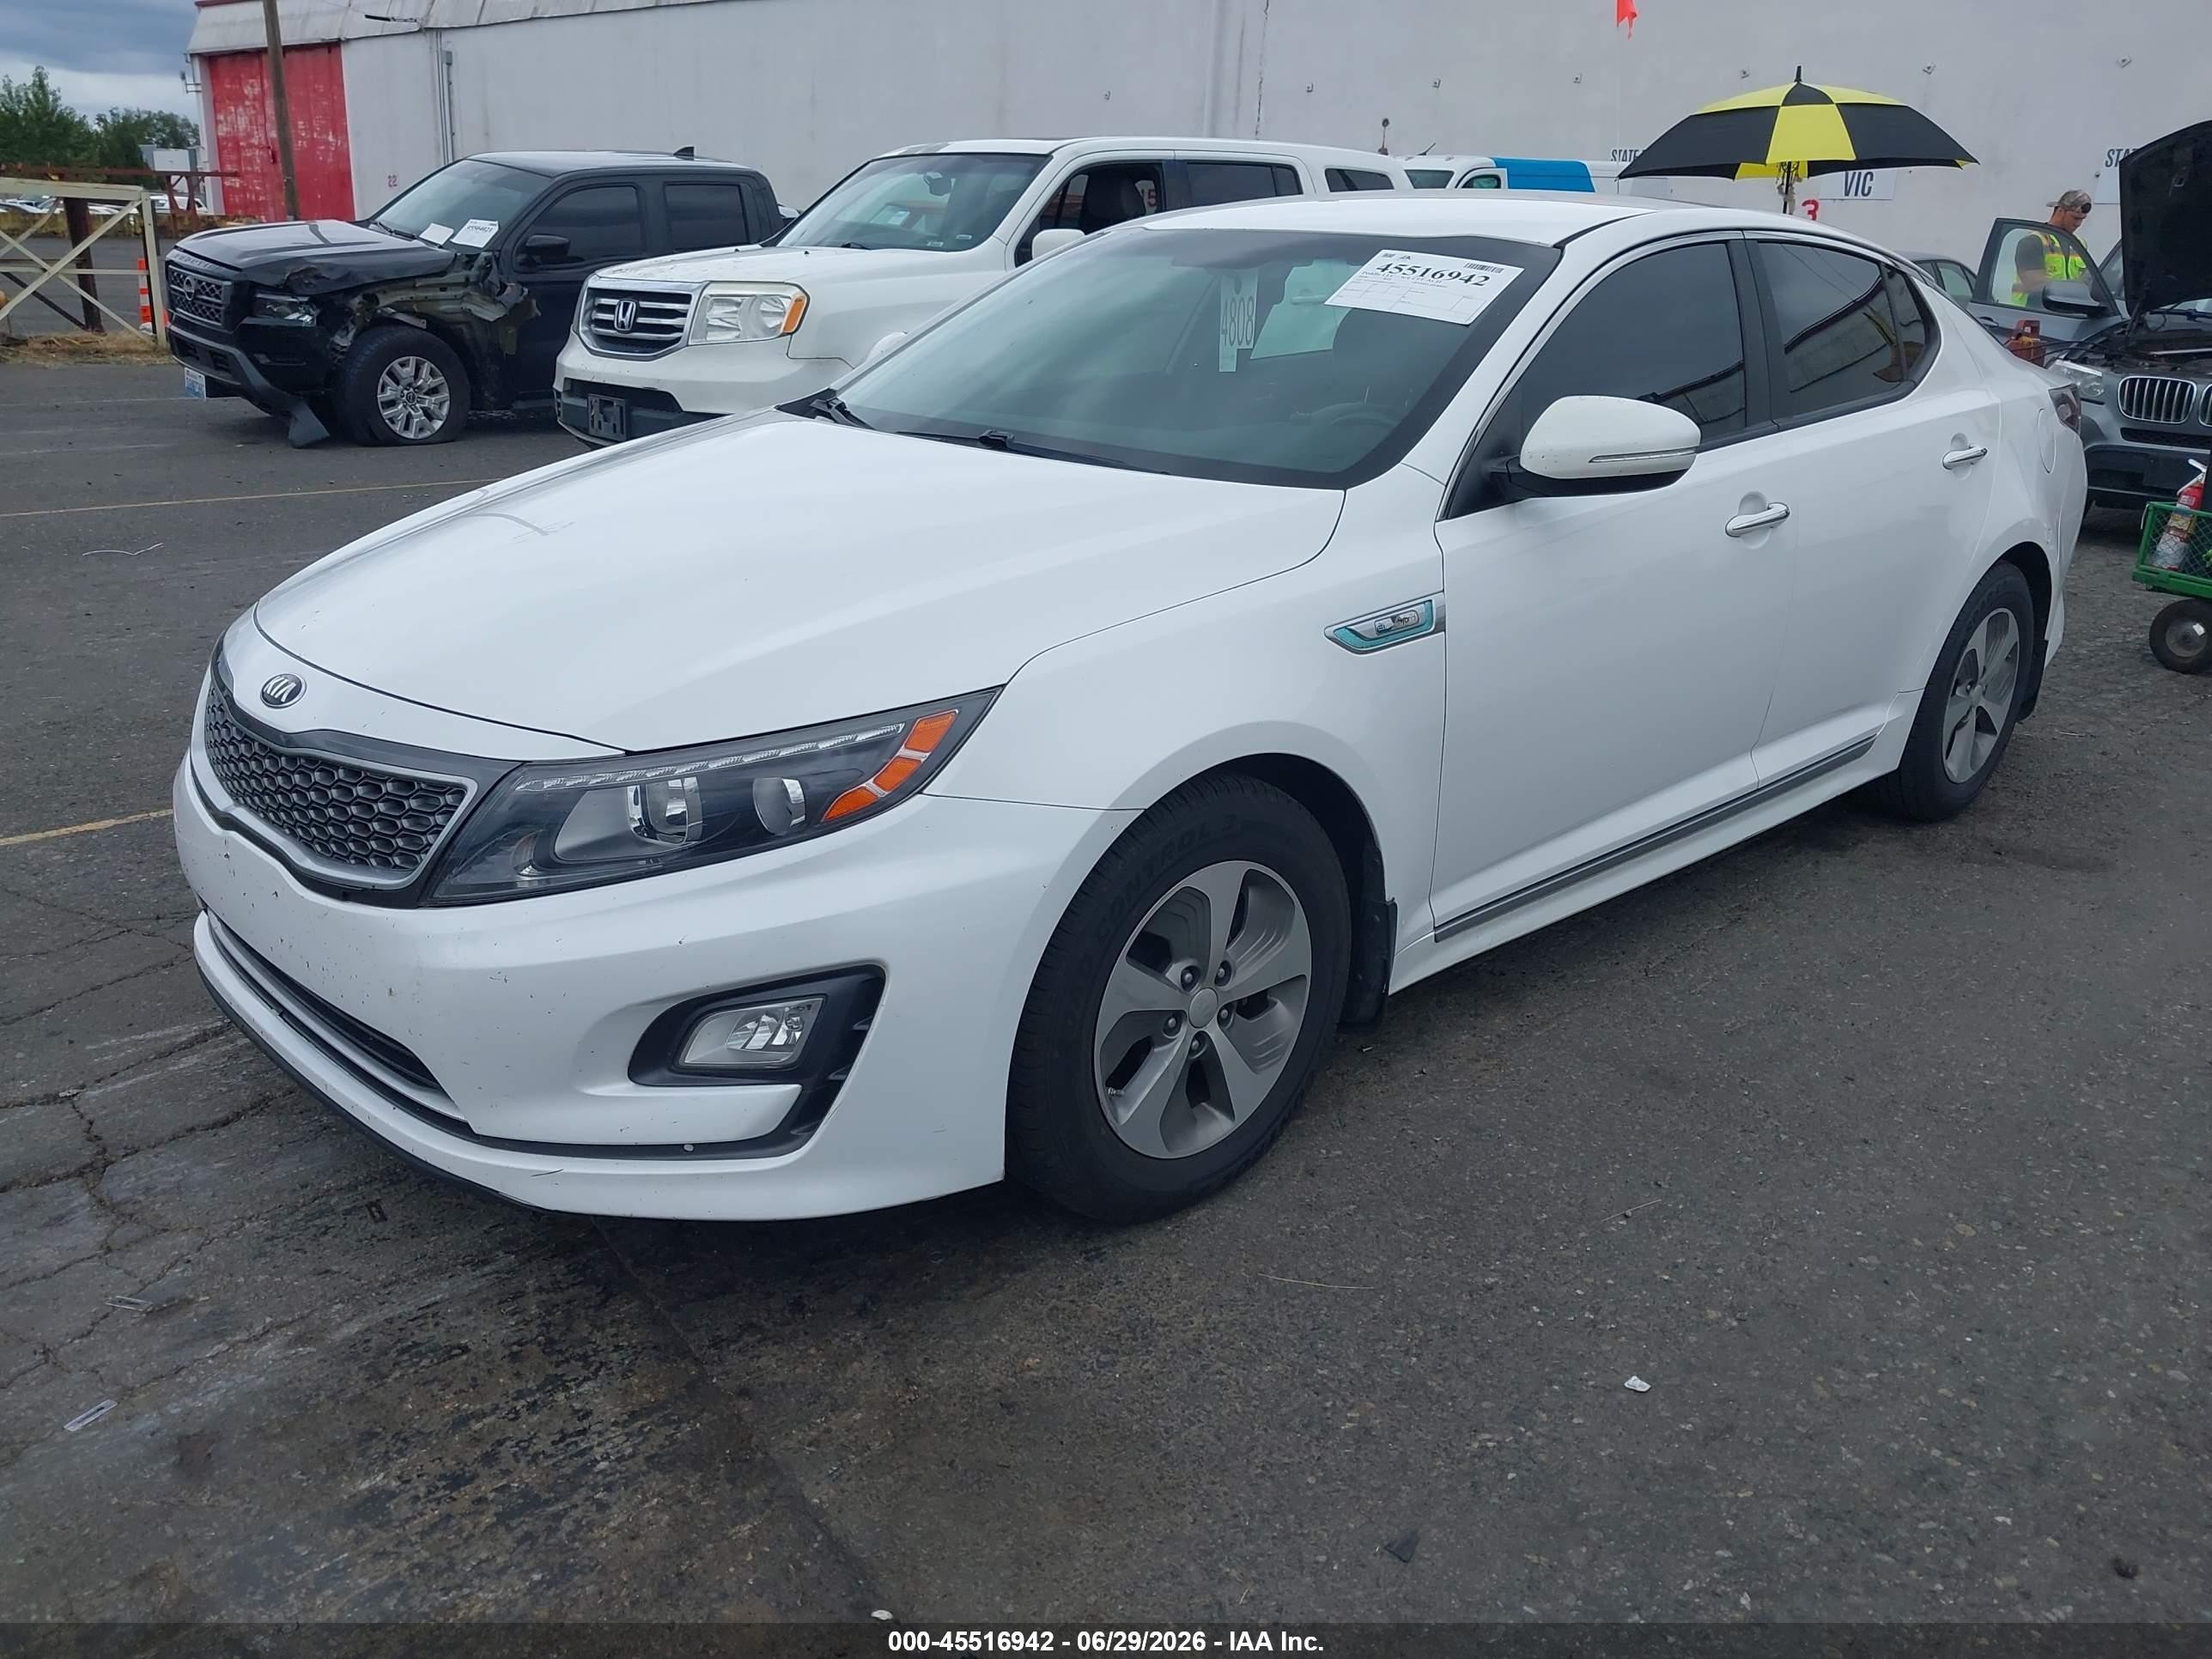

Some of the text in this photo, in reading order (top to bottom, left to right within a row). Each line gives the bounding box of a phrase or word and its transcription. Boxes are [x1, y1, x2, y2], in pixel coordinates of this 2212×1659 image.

[2105, 148, 2139, 167] ST
[387, 174, 398, 187] 22
[1844, 171, 1874, 197] VIC
[1801, 199, 1820, 221] 3
[1376, 263, 1490, 286] 45516942
[1221, 295, 1255, 346] 4808
[263, 676, 297, 702] KIA
